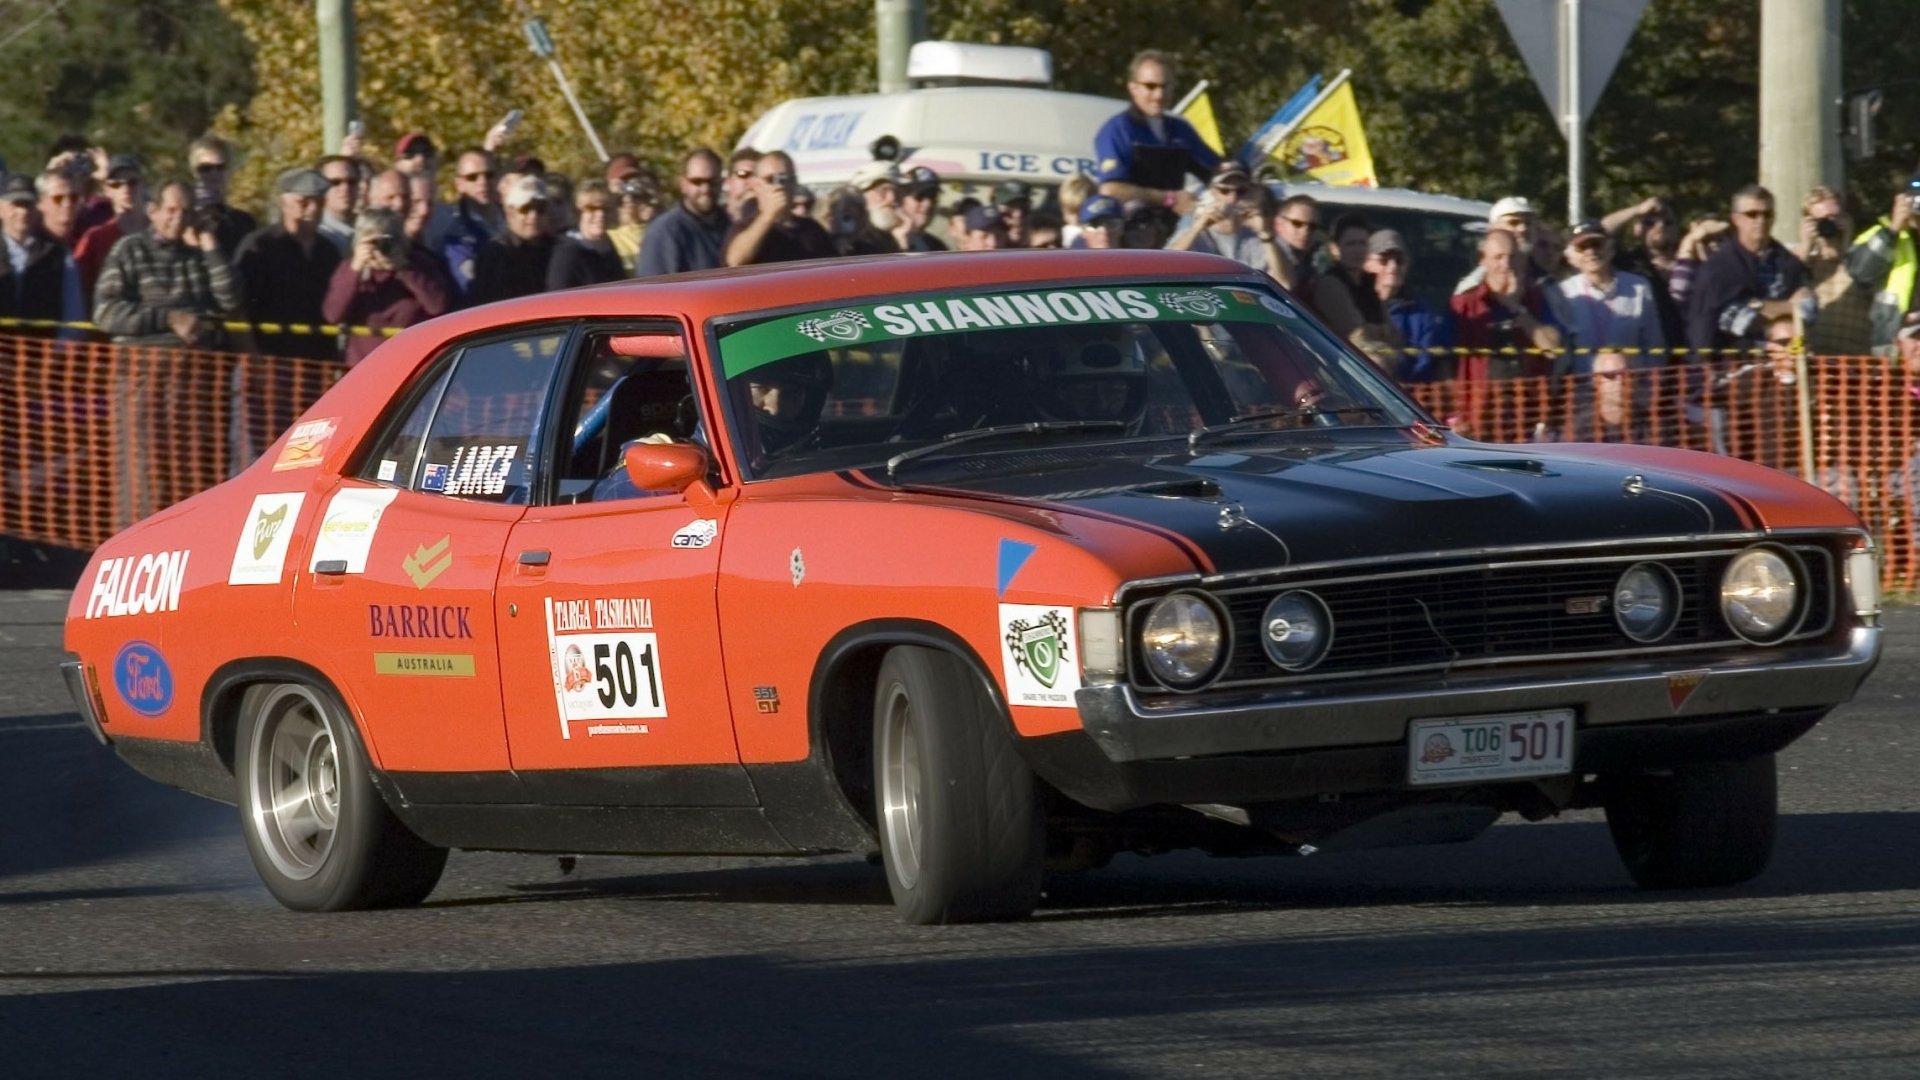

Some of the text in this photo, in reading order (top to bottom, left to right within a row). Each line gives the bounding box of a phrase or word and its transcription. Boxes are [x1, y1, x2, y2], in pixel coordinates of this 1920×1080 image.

[979, 152, 1038, 172] ICE
[873, 289, 1159, 335] SHANNONS
[85, 549, 191, 620] FALCON
[369, 604, 473, 639] BARRICK
[554, 598, 653, 631] TARGA TASMANIA
[127, 652, 163, 700] Ford
[397, 658, 453, 671] AUSTRALIA
[594, 641, 660, 709] 501
[753, 687, 777, 699] 351
[756, 699, 779, 713] GT
[1510, 719, 1566, 762] 501
